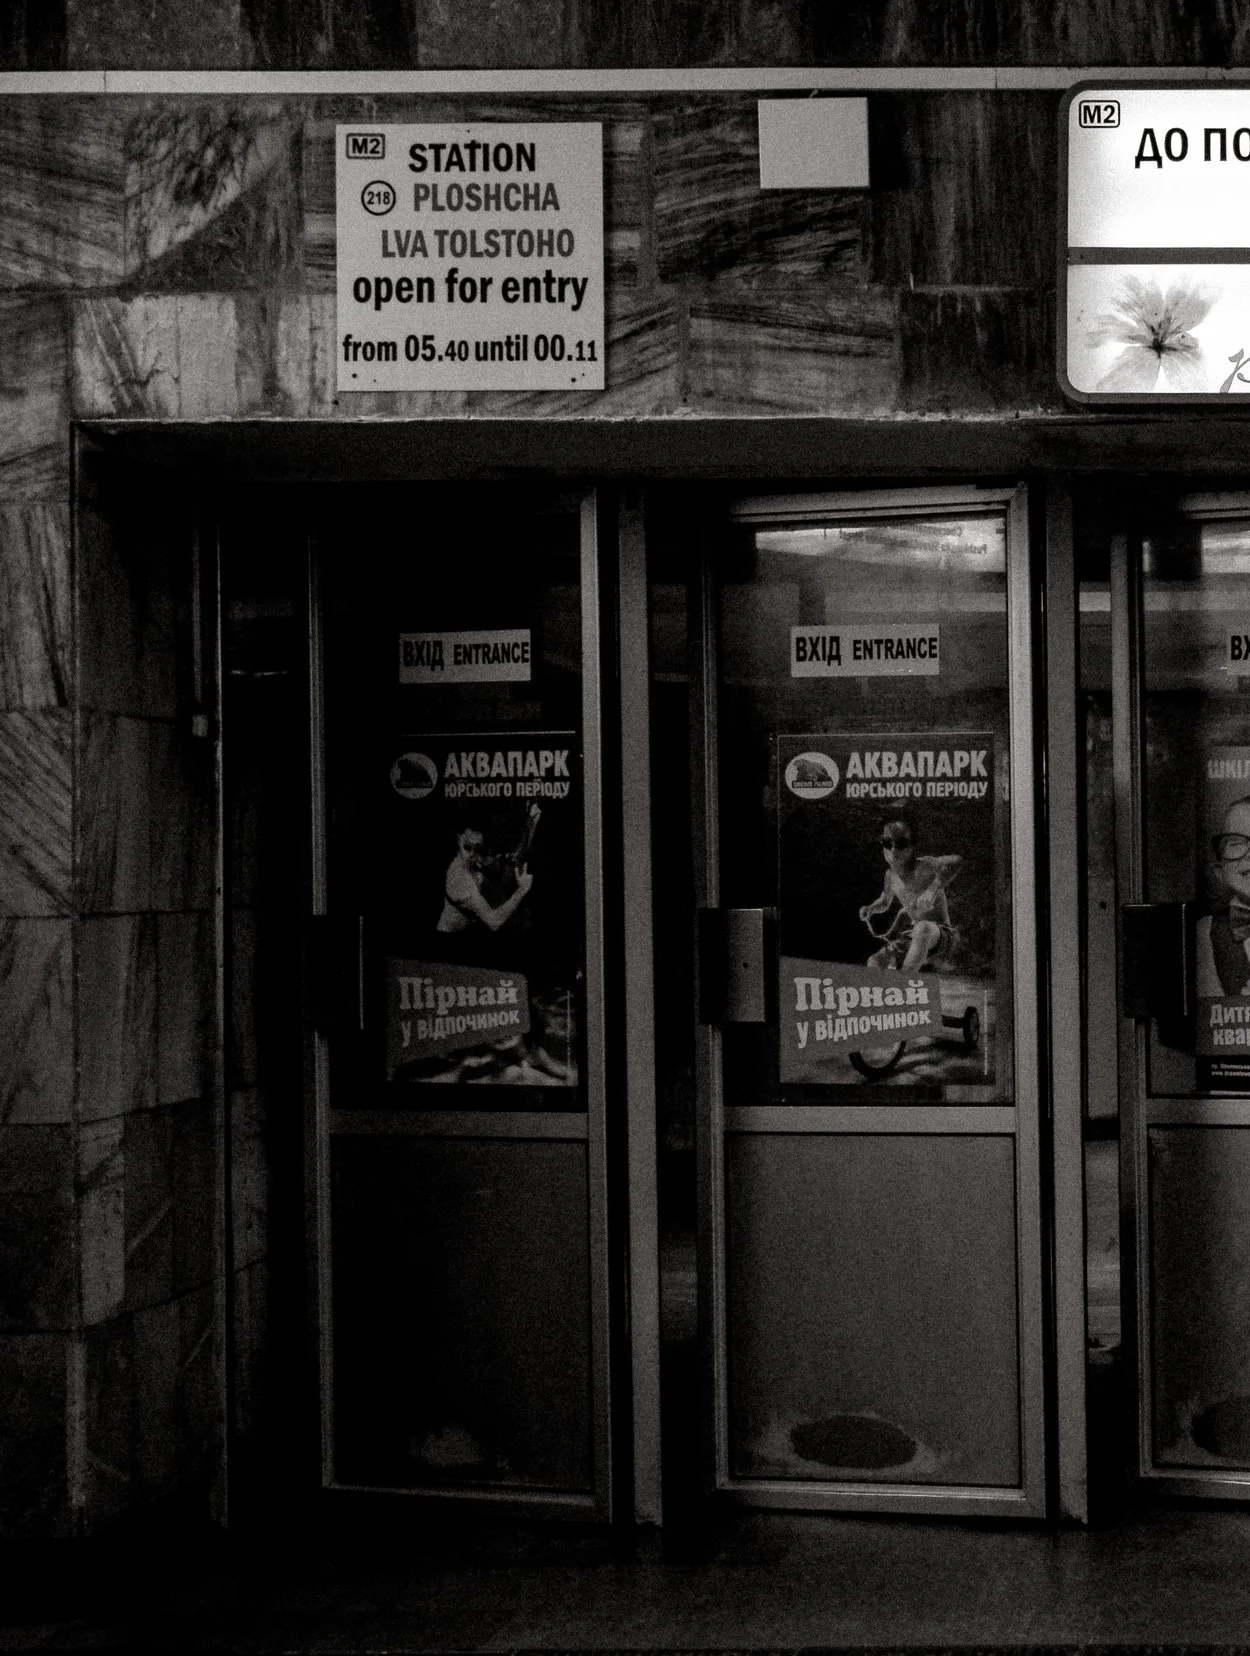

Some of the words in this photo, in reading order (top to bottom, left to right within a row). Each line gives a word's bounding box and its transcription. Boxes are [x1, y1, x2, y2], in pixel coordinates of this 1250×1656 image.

[1083, 104, 1116, 124] M2
[351, 137, 381, 155] M2
[408, 142, 536, 173] STATION
[1135, 127, 1189, 169] ДО
[366, 191, 391, 205] 218
[413, 182, 561, 212] PLOSHCHA
[381, 229, 429, 258] LVA
[434, 228, 575, 258] TOLSTOHO
[352, 274, 435, 311] open
[445, 267, 493, 303] for
[501, 269, 588, 311] entry
[342, 334, 397, 361] from
[404, 334, 469, 361] 05.40
[474, 334, 528, 361] until
[534, 334, 597, 362] 00.11
[403, 640, 444, 670] ВХІД
[453, 642, 530, 665] ENTRANCE
[796, 636, 842, 666] ВХІД
[852, 637, 938, 660] ENTRANCE
[444, 750, 571, 778] АКВАПАРК
[845, 750, 988, 778] АКВАПАРК
[444, 782, 512, 799] ЮРСЬКОГО
[515, 780, 571, 799] ПЕРІОДУ
[845, 781, 922, 798] ЮРСЬКОГО
[926, 780, 988, 800] ПЕРІОДУ
[398, 977, 519, 1016] Пірнай
[793, 976, 930, 1016] Пірнай
